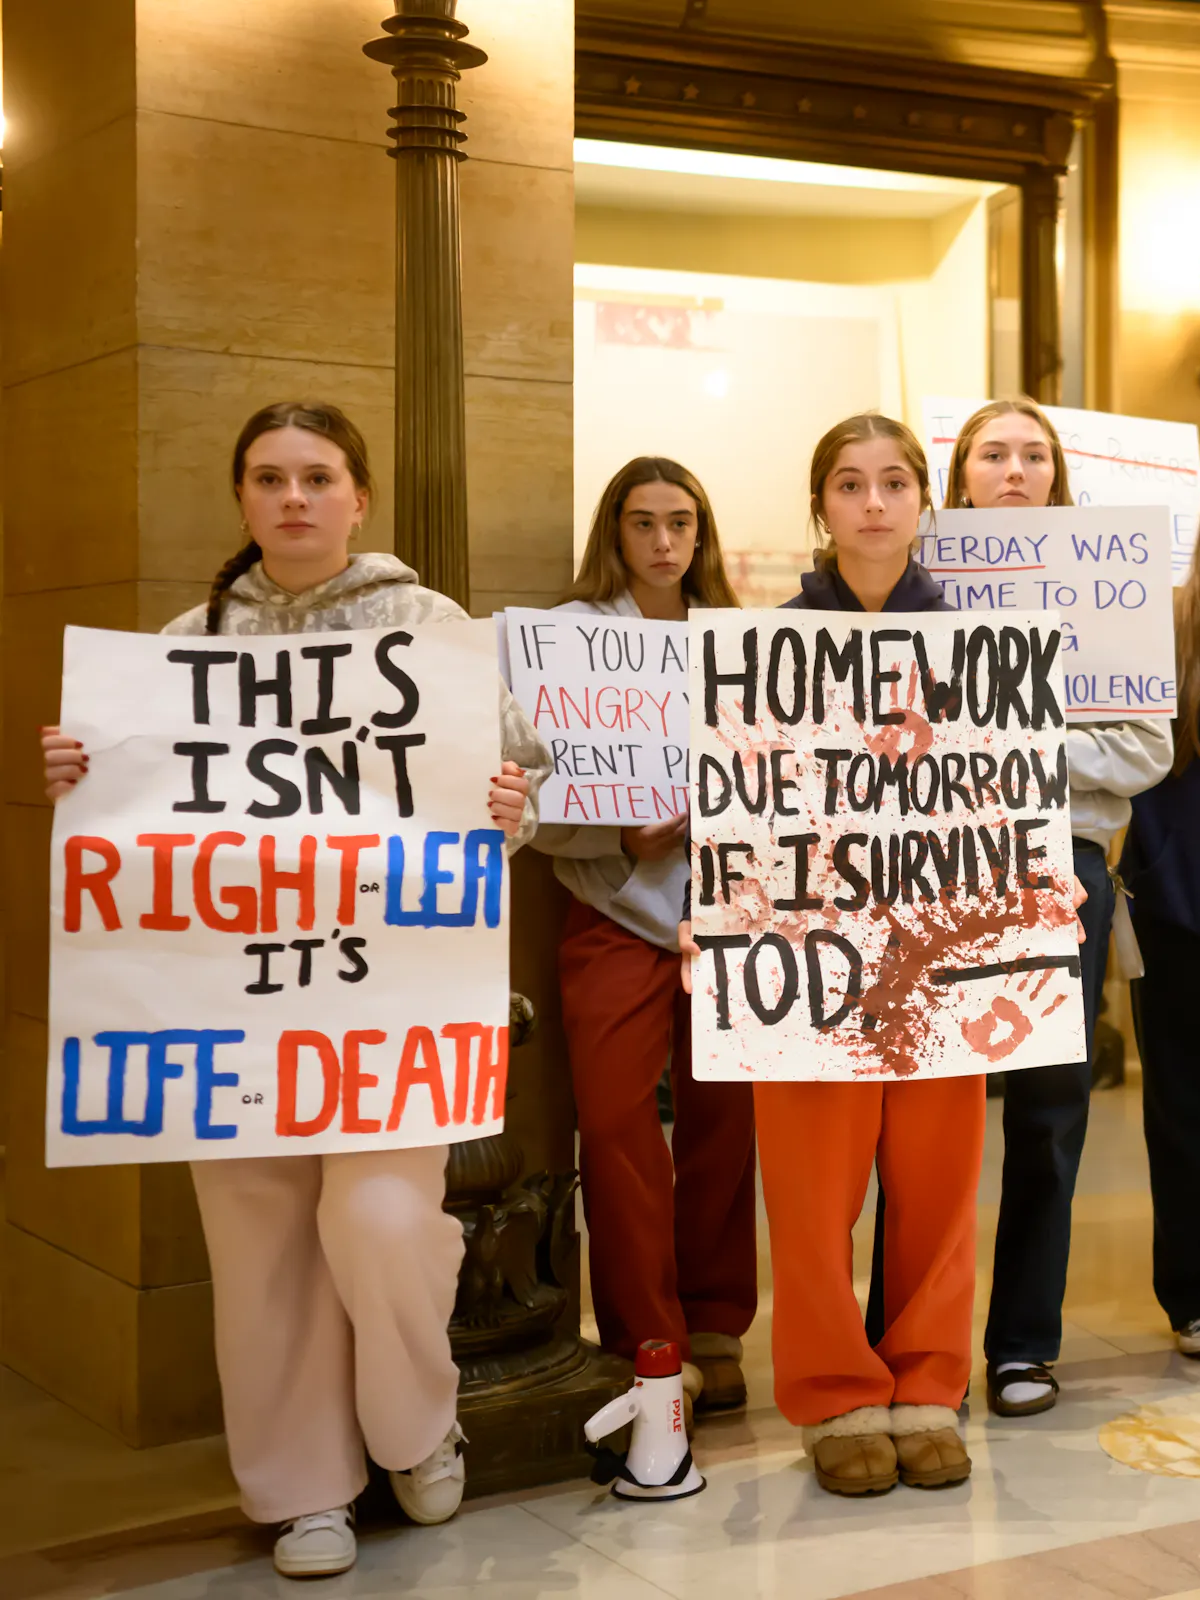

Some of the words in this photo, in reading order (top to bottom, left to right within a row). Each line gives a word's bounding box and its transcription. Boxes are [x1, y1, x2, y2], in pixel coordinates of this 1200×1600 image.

[917, 533, 1048, 566] TERDAY
[1071, 532, 1149, 565] WAS
[1034, 580, 1077, 609] TO
[1094, 579, 1147, 610] DO
[166, 630, 420, 736] THIS
[519, 624, 557, 671] IF
[576, 624, 645, 673] YOU
[702, 626, 1065, 731] HOMEWORK
[533, 684, 671, 738] ANGRY
[1064, 674, 1177, 706] IOLENCE
[172, 726, 426, 819] ISN'T
[551, 738, 643, 778] REN'T
[699, 748, 799, 818] DUE
[814, 742, 1069, 817] TOMORROW
[563, 782, 690, 821] ATTENT
[63, 829, 380, 934] RIGHT
[359, 882, 380, 894] OR
[698, 841, 755, 906] IF
[772, 831, 826, 911] I
[832, 818, 1054, 912] SURVIVE
[244, 927, 370, 995] IT'S
[692, 928, 878, 1032] TOD
[60, 1028, 246, 1140] LIFE
[242, 1093, 264, 1105] OR
[274, 1021, 510, 1137] DEATH
